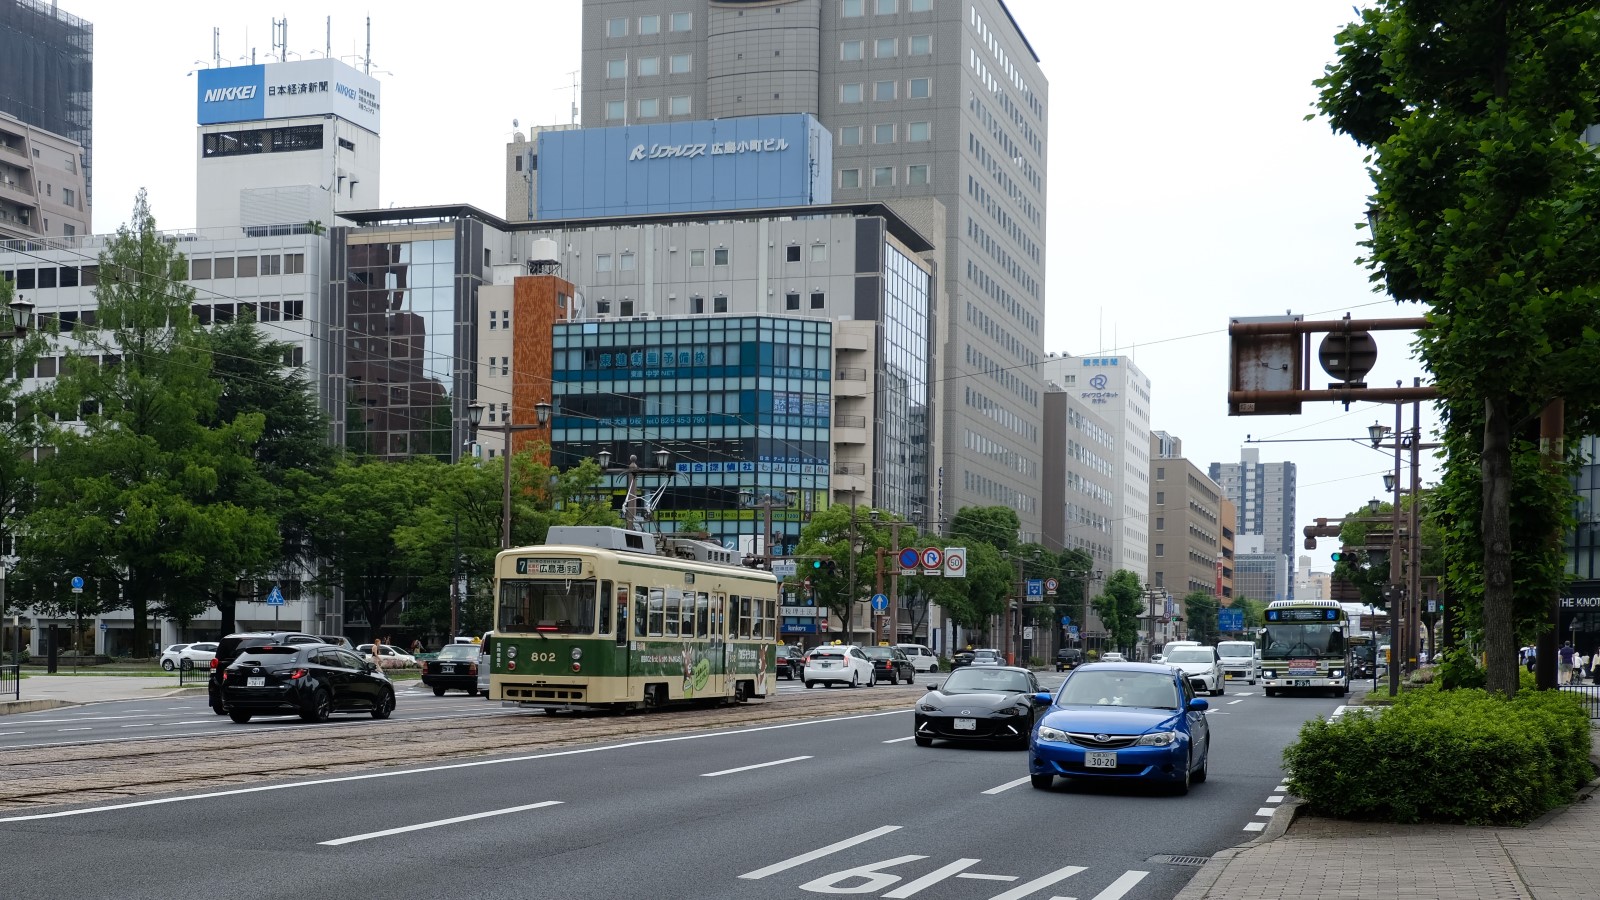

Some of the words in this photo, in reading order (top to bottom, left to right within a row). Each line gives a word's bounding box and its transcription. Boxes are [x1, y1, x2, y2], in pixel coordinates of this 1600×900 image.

[268, 81, 329, 96] 日本経済新聞
[335, 82, 357, 100] NIKKEI
[204, 85, 257, 103] NIKKEI
[649, 143, 707, 159] リファレンス
[710, 138, 789, 155] 広島小町ビル
[1081, 391, 1119, 399] ダイワロイネット
[678, 463, 752, 472] 総合探偵社
[519, 561, 526, 572] 7
[950, 558, 960, 567] 50
[540, 564, 565, 574] 広島港
[530, 652, 556, 662] 802
[1092, 757, 1115, 767] 30-20
